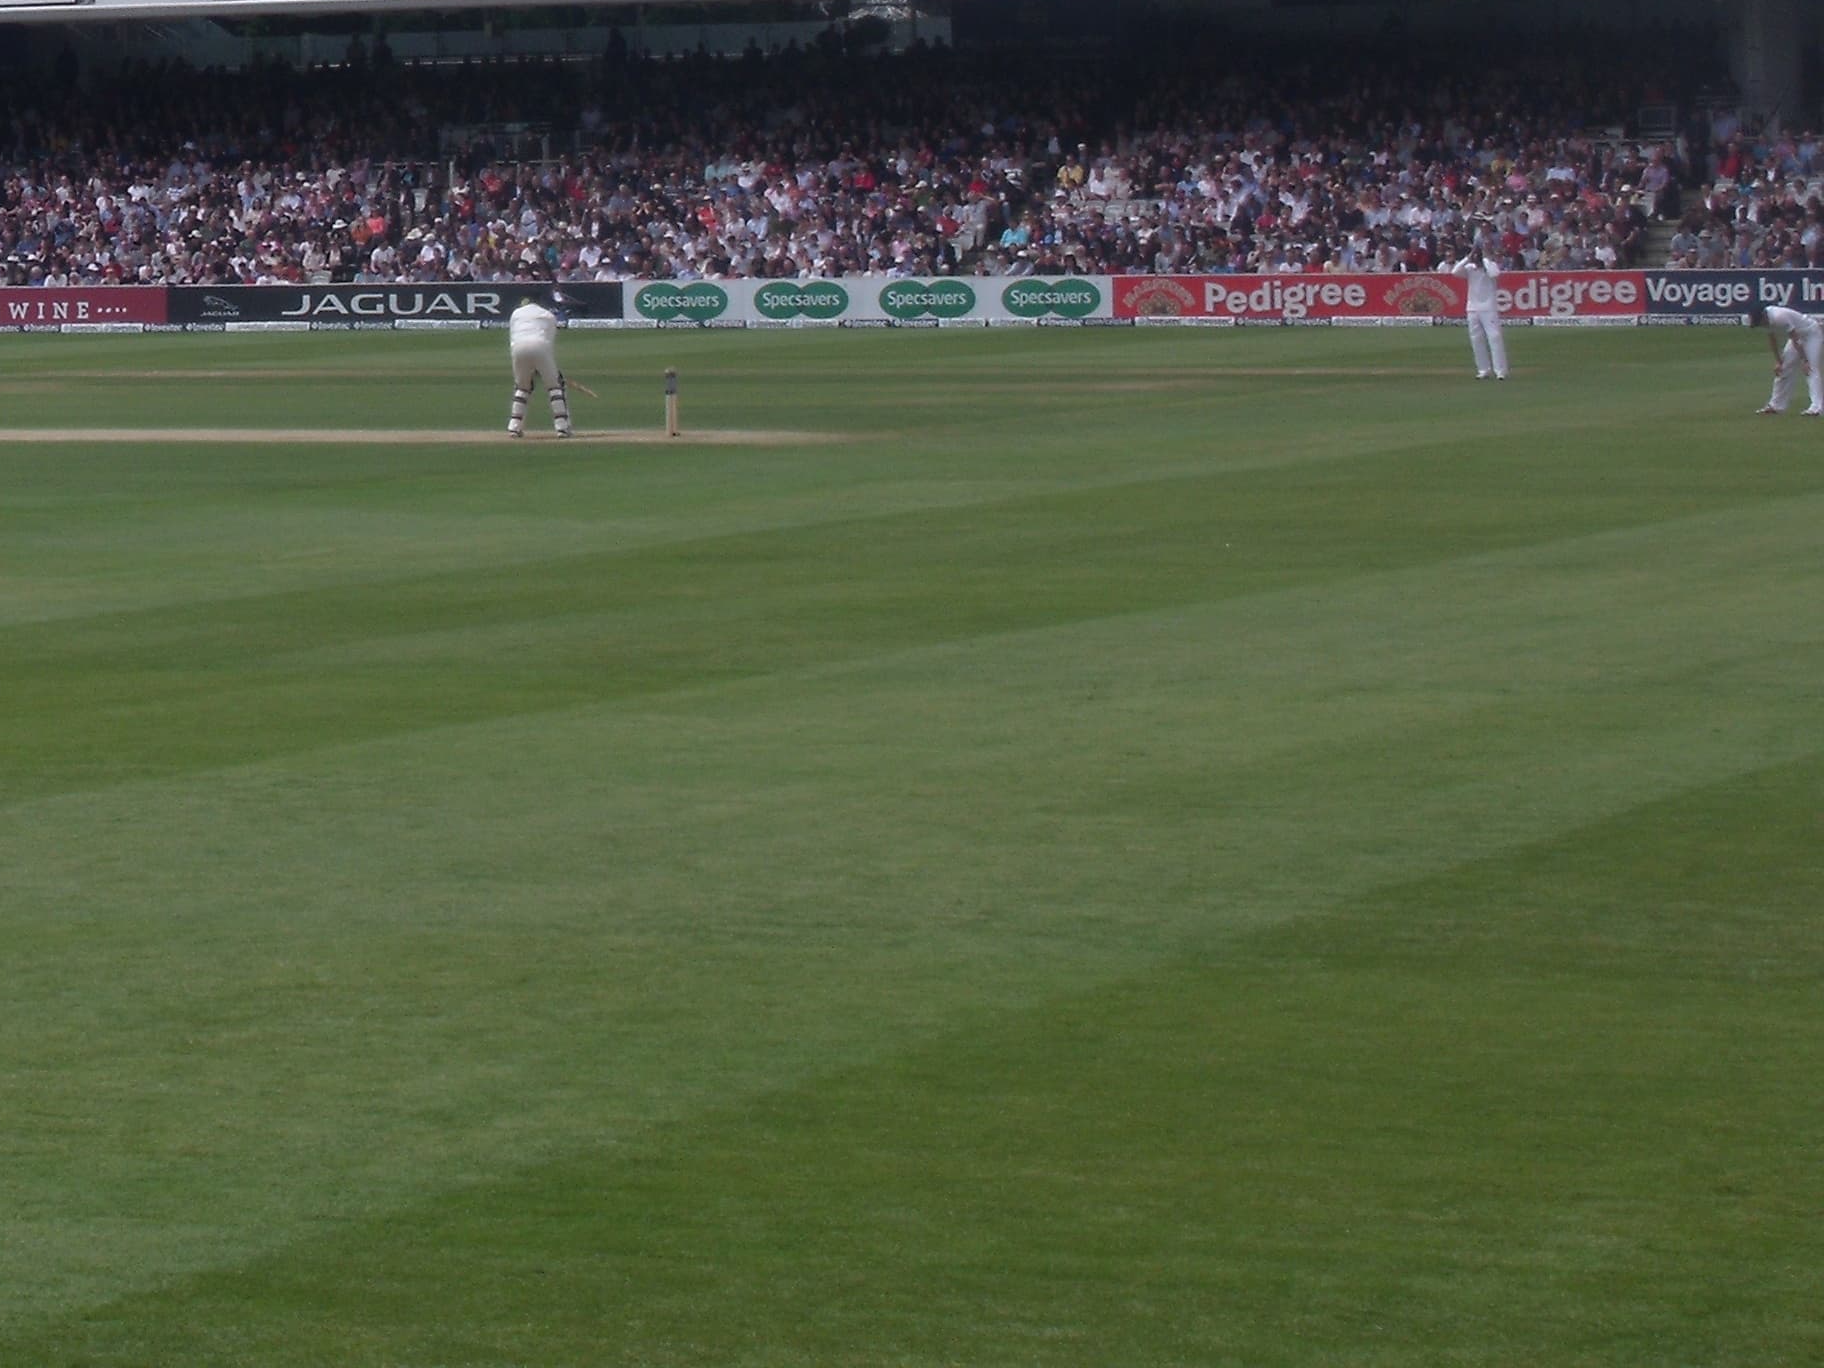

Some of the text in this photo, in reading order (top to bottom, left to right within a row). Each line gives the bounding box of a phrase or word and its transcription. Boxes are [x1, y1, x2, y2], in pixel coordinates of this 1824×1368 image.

[642, 293, 720, 308] Specsavers
[762, 291, 840, 308] Specsavers
[887, 290, 967, 307] Specsavers
[1010, 289, 1092, 306] Specsavers
[1204, 280, 1366, 318] Pedigree
[1495, 277, 1637, 317] edigree
[1645, 278, 1749, 308] Voyage
[1759, 278, 1793, 307] by
[8, 301, 90, 321] WINE
[281, 292, 501, 315] JAGUAR
